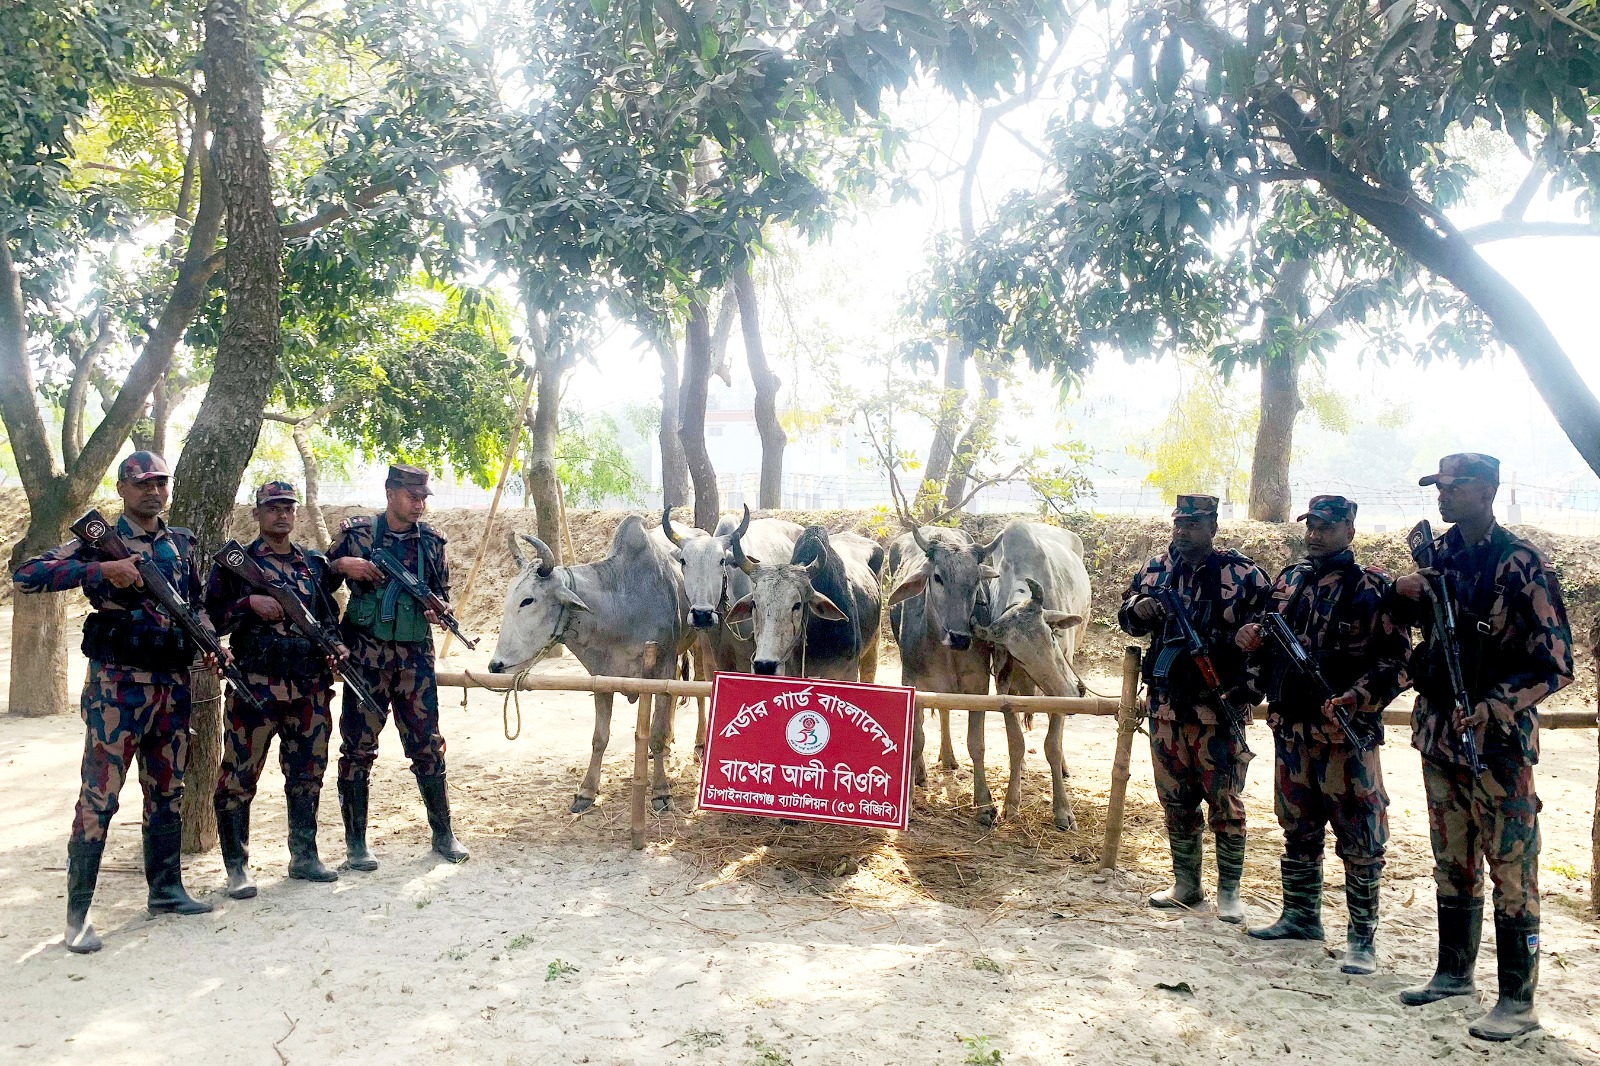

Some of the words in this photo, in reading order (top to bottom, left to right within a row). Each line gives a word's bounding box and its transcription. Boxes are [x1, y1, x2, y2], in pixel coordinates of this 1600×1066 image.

[719, 700, 768, 738] বর্ডার
[773, 686, 814, 710] গার্ড
[817, 692, 898, 755] বাংলাদেশ
[719, 759, 776, 785] বাখের
[780, 759, 828, 790] আলী
[832, 762, 892, 797] বিওপি
[706, 784, 774, 806] চাঁপাইনবাবগঞ্জ
[778, 792, 829, 812] ব্যাটালিয়ন
[832, 798, 855, 815] (৫৩
[858, 799, 898, 821] বিজিবি)
